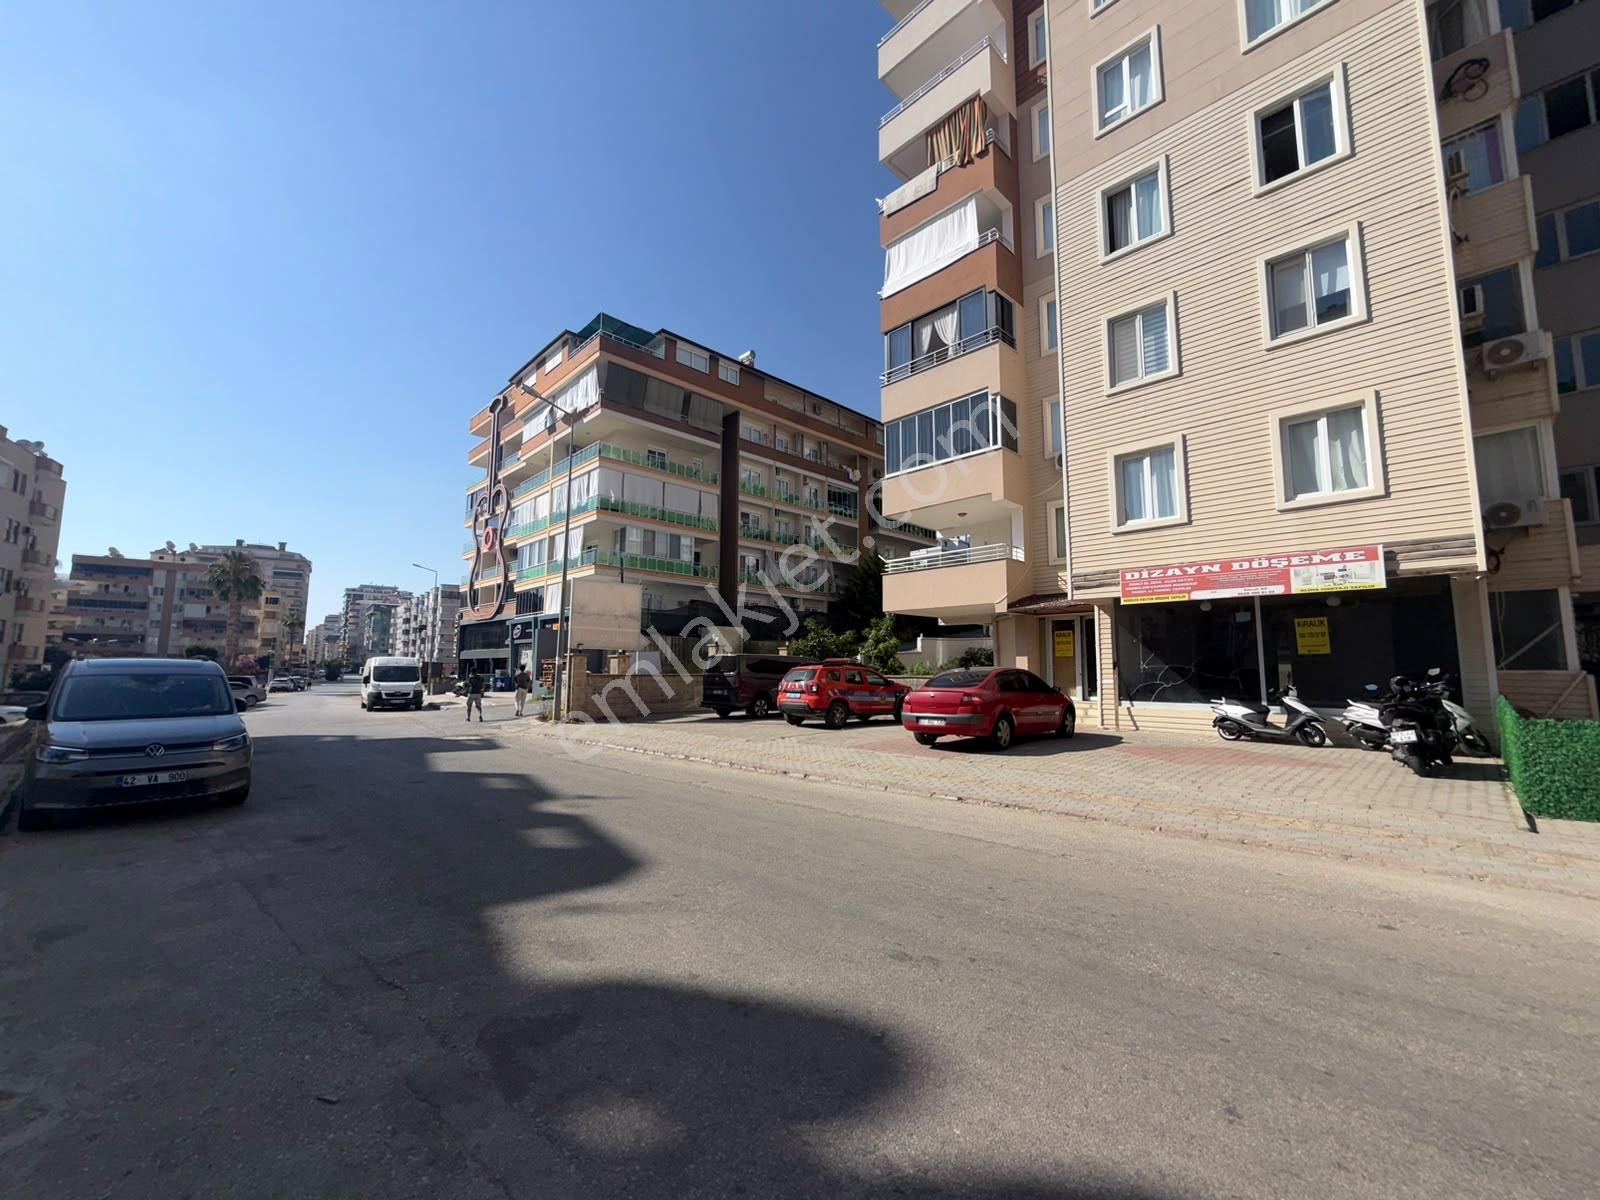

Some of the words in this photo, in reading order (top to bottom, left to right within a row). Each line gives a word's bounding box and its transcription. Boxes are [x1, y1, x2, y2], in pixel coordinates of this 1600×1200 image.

[1231, 551, 1366, 571] DÖŞEME
[123, 775, 137, 785] 42
[147, 773, 159, 784] VA
